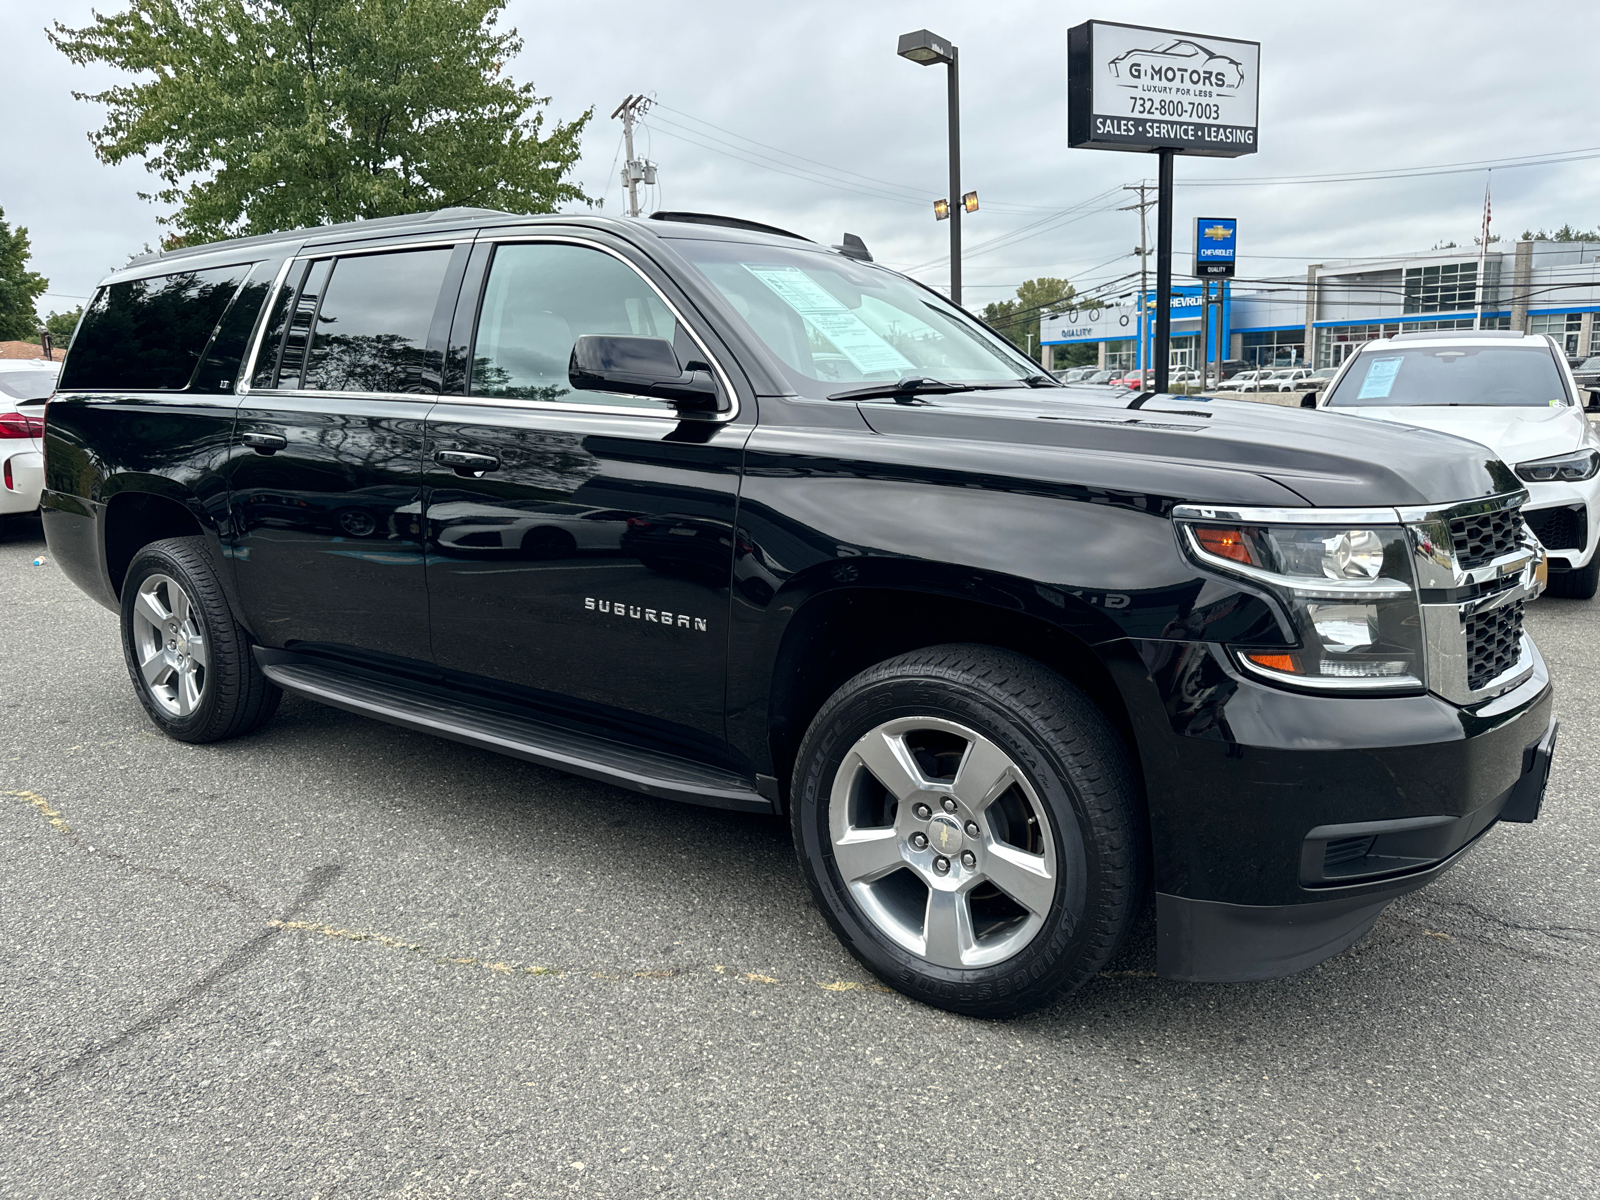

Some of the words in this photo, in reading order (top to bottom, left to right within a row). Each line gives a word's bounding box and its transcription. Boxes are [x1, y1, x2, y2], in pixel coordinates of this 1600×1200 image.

[1141, 84, 1173, 95] LUXURY
[1175, 87, 1191, 96] FOR
[1193, 89, 1213, 98] LESS
[1129, 96, 1220, 120] 732-800-7003
[1096, 117, 1135, 136] SALES
[1146, 122, 1195, 140] SERVICE
[1204, 126, 1253, 144] LEASING
[1201, 248, 1234, 257] CHEVROLET
[1061, 327, 1092, 338] QUALITY
[584, 597, 707, 632] SUBURBAN
[981, 719, 1037, 770] ALENZA
